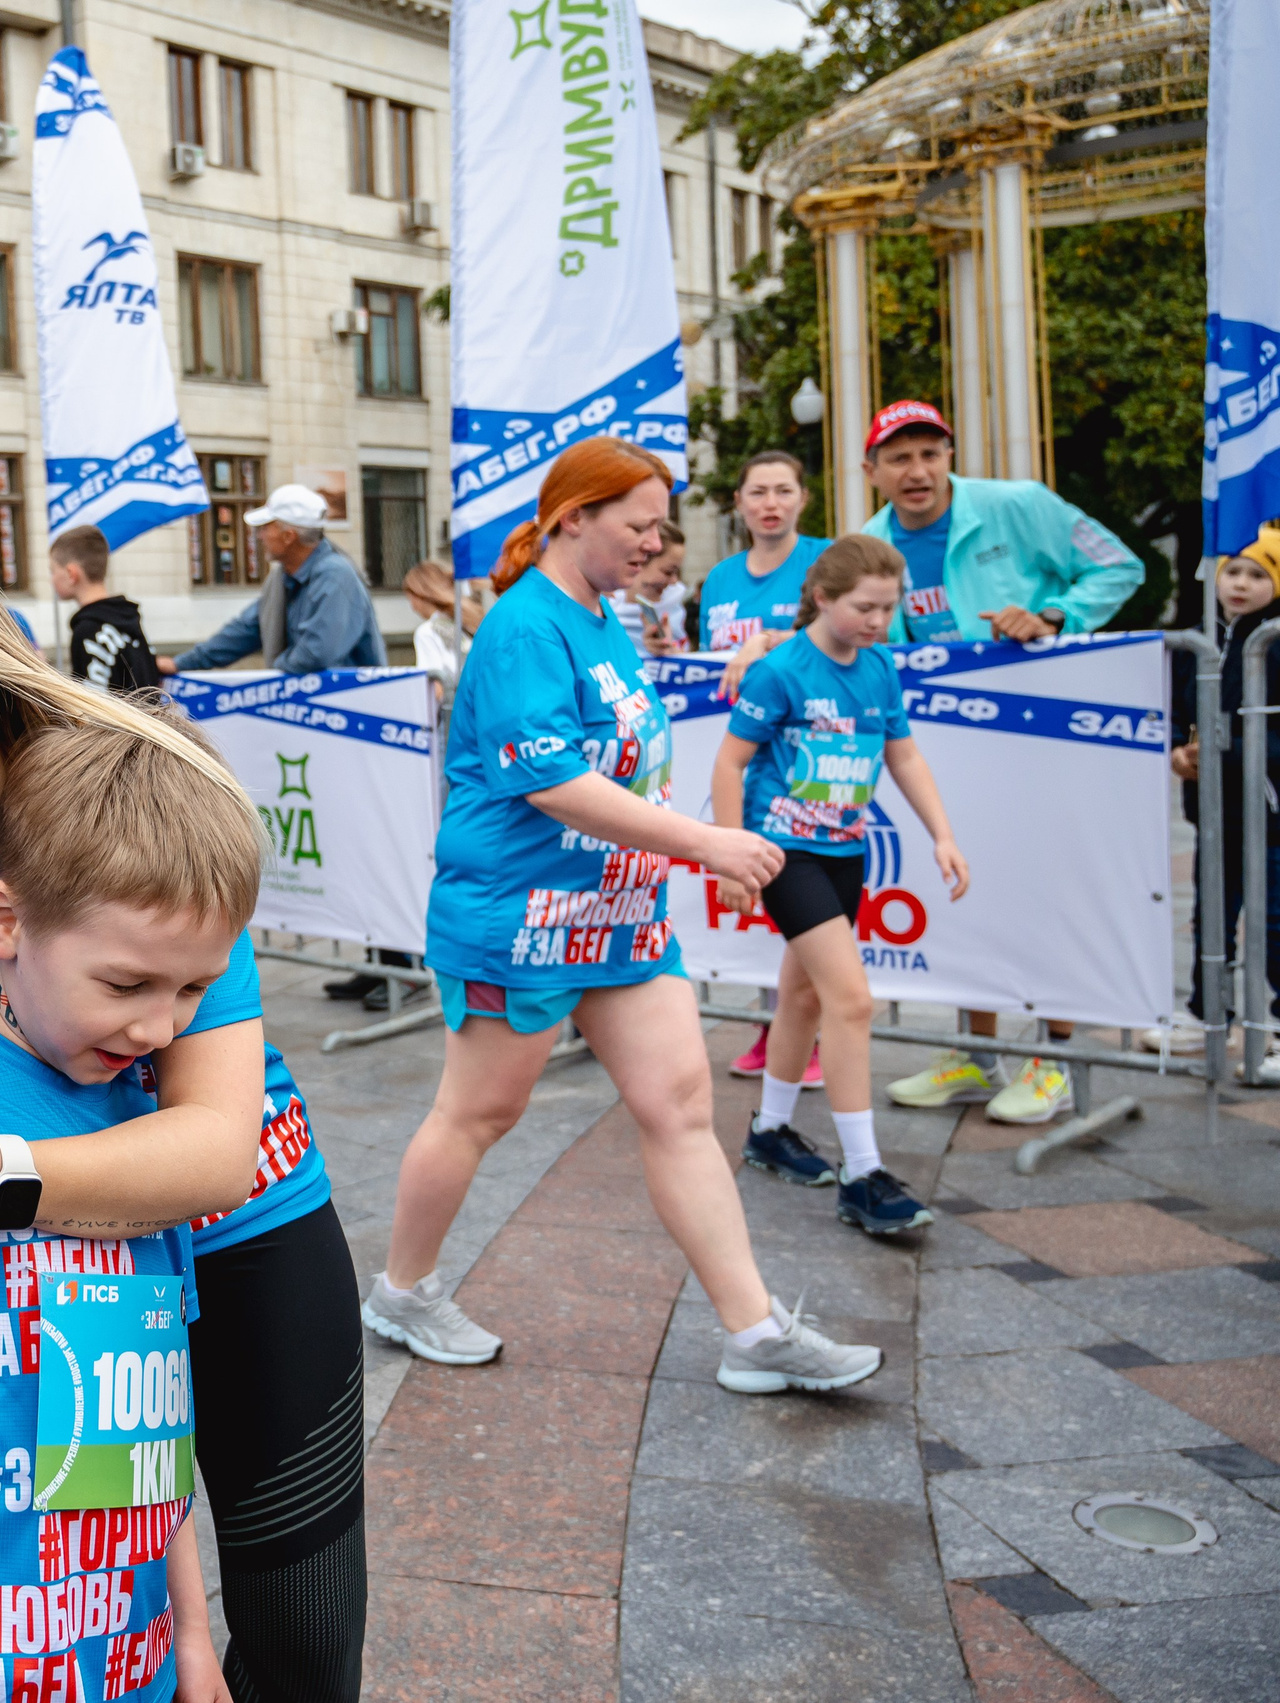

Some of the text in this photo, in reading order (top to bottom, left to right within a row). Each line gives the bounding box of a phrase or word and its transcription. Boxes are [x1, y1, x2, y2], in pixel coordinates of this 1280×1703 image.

[60, 281, 157, 309] ЯЛТА
[115, 309, 145, 325] ТВ
[216, 673, 322, 713] ЗАБЕГ.РФ
[525, 887, 658, 929] #ЛЮБОВЬ
[511, 927, 612, 967] #ЗАБЕГ
[83, 1284, 119, 1303] ПСБ
[93, 1348, 188, 1431] 10068
[129, 1438, 176, 1507] 1КМ
[39, 1497, 187, 1582] #ГОРДО
